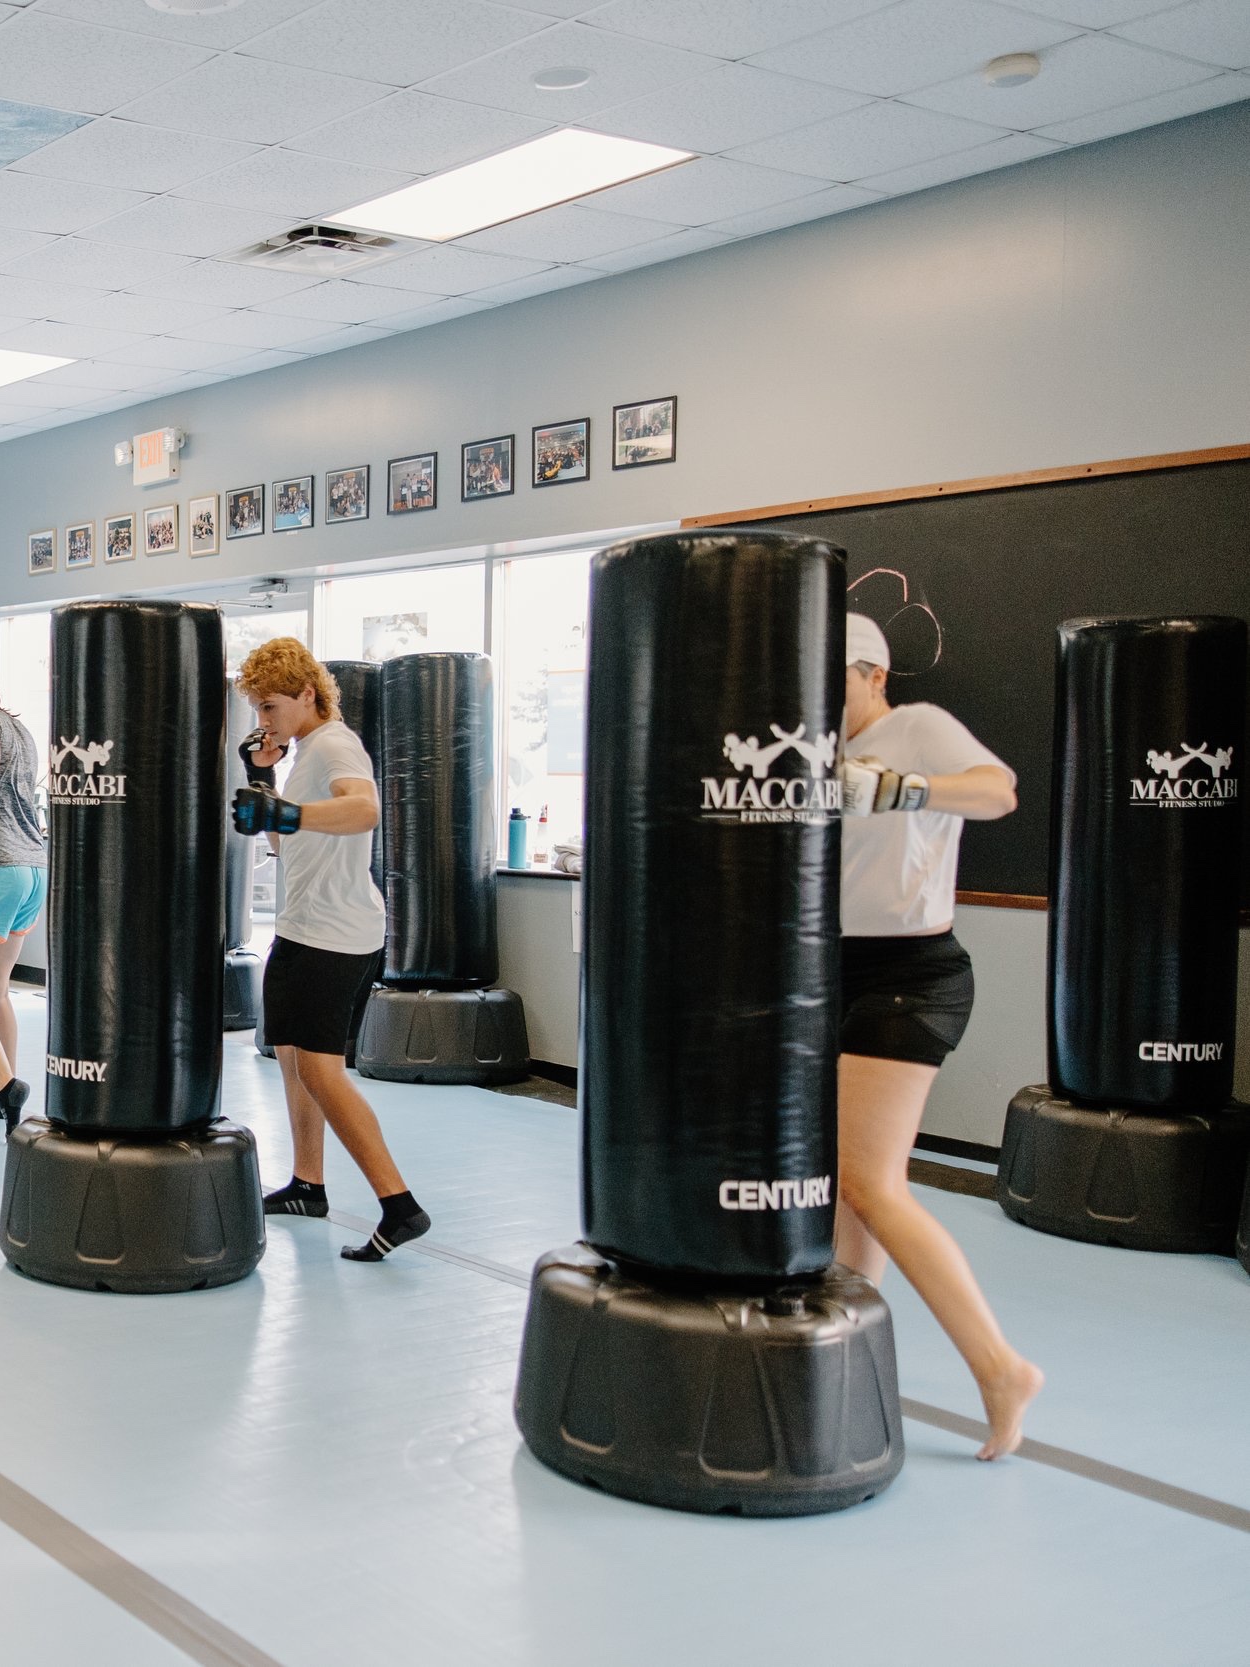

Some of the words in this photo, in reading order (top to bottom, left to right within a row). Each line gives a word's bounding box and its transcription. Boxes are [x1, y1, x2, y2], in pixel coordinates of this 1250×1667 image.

[140, 432, 164, 469] EXIT
[50, 774, 127, 797] ACCABI
[700, 777, 843, 810] MACCABI
[1130, 779, 1238, 800] MACCABI
[71, 798, 101, 806] STUDIO
[1159, 800, 1197, 808] FITNESS
[740, 810, 793, 823] FITNESS
[719, 1174, 831, 1210] CENTURY
